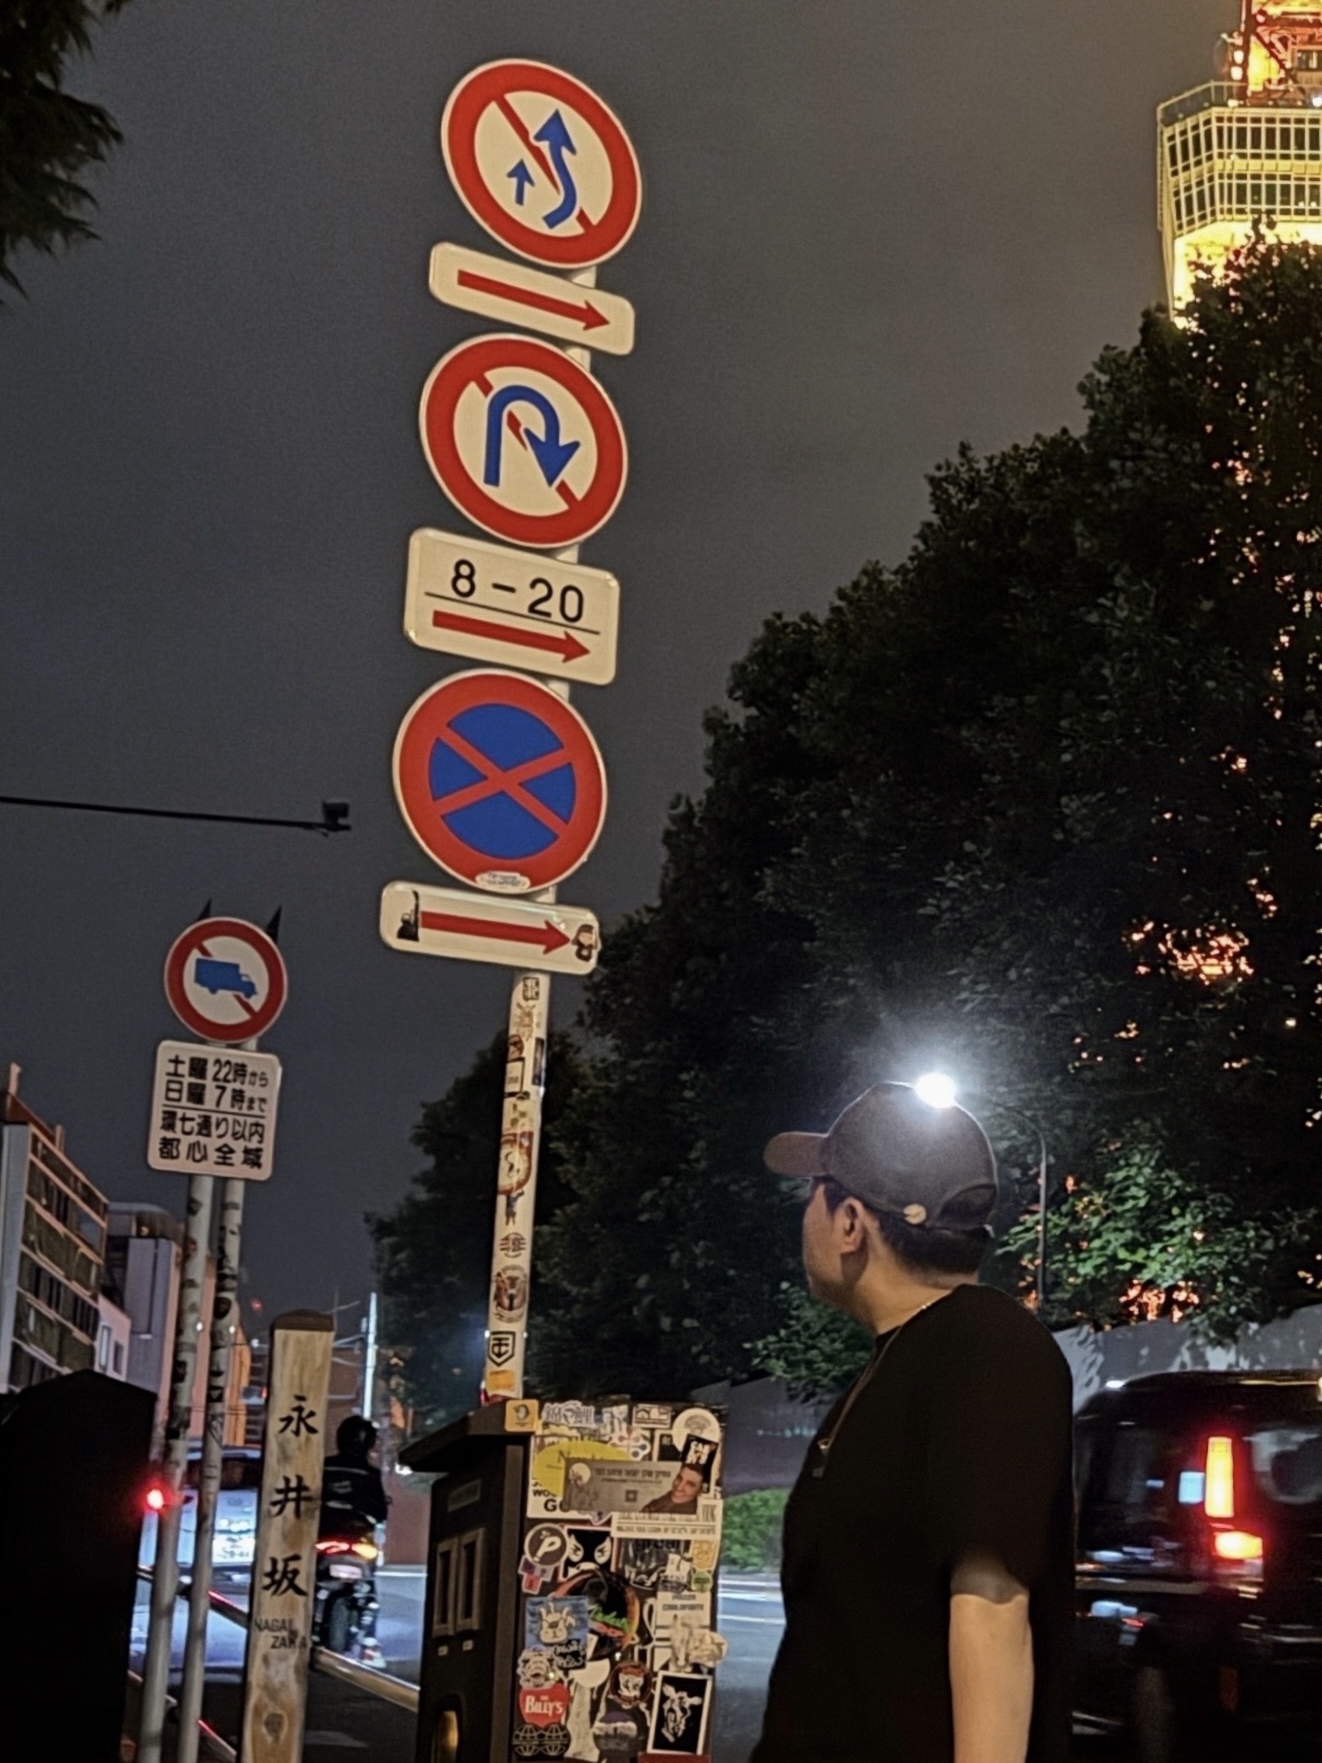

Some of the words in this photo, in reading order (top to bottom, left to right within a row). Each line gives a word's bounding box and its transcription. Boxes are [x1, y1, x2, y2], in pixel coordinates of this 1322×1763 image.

[160, 1110, 266, 1144] 環七通り以内
[158, 1136, 264, 1170] 都心全域
[262, 1395, 319, 1596] 永井坂
